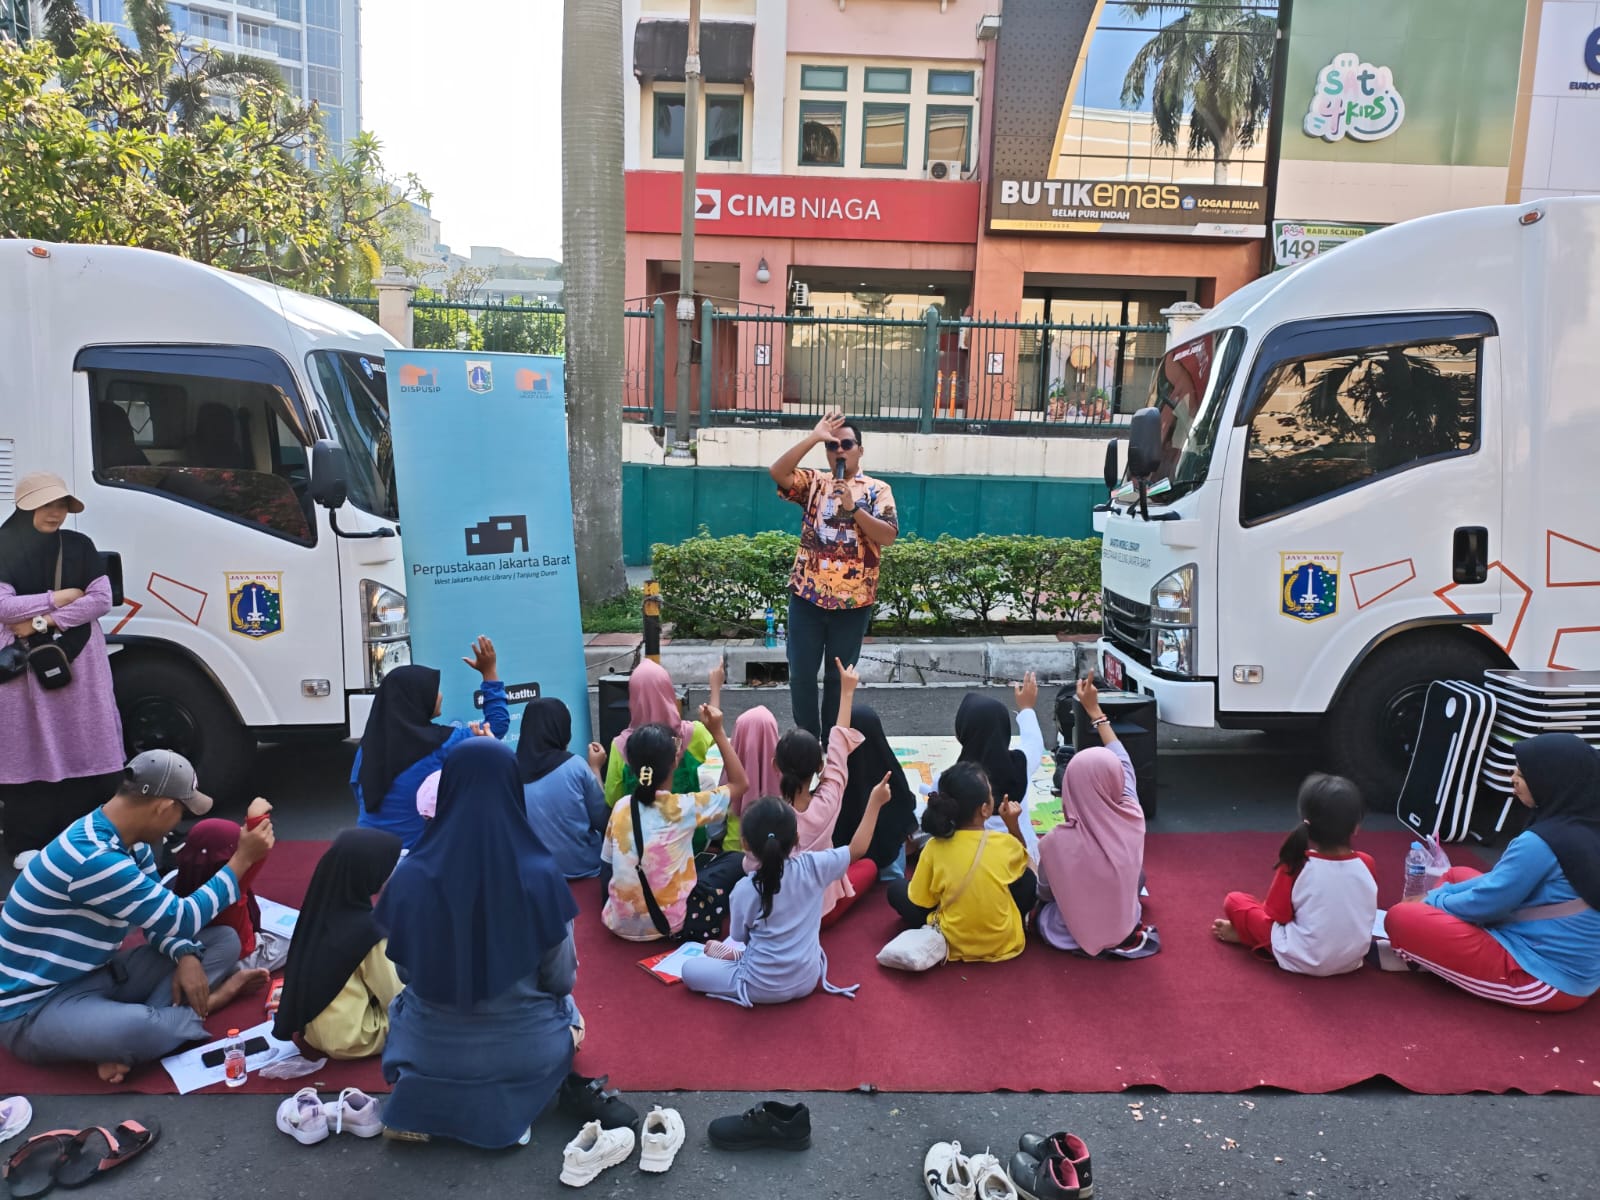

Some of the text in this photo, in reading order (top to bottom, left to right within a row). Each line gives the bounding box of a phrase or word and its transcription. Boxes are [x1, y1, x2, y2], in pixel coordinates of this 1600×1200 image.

[727, 194, 881, 220] CIMB NIAGA
[1231, 200, 1259, 210] MULIA
[1051, 208, 1130, 220] BELM PURI INDAH
[1330, 228, 1364, 236] SCALING
[1279, 238, 1316, 259] 149
[400, 385, 441, 393] DISPUSIP
[412, 555, 571, 576] Perpustakaan Jakarta Barat
[434, 577, 450, 585] West
[491, 572, 513, 581] Library
